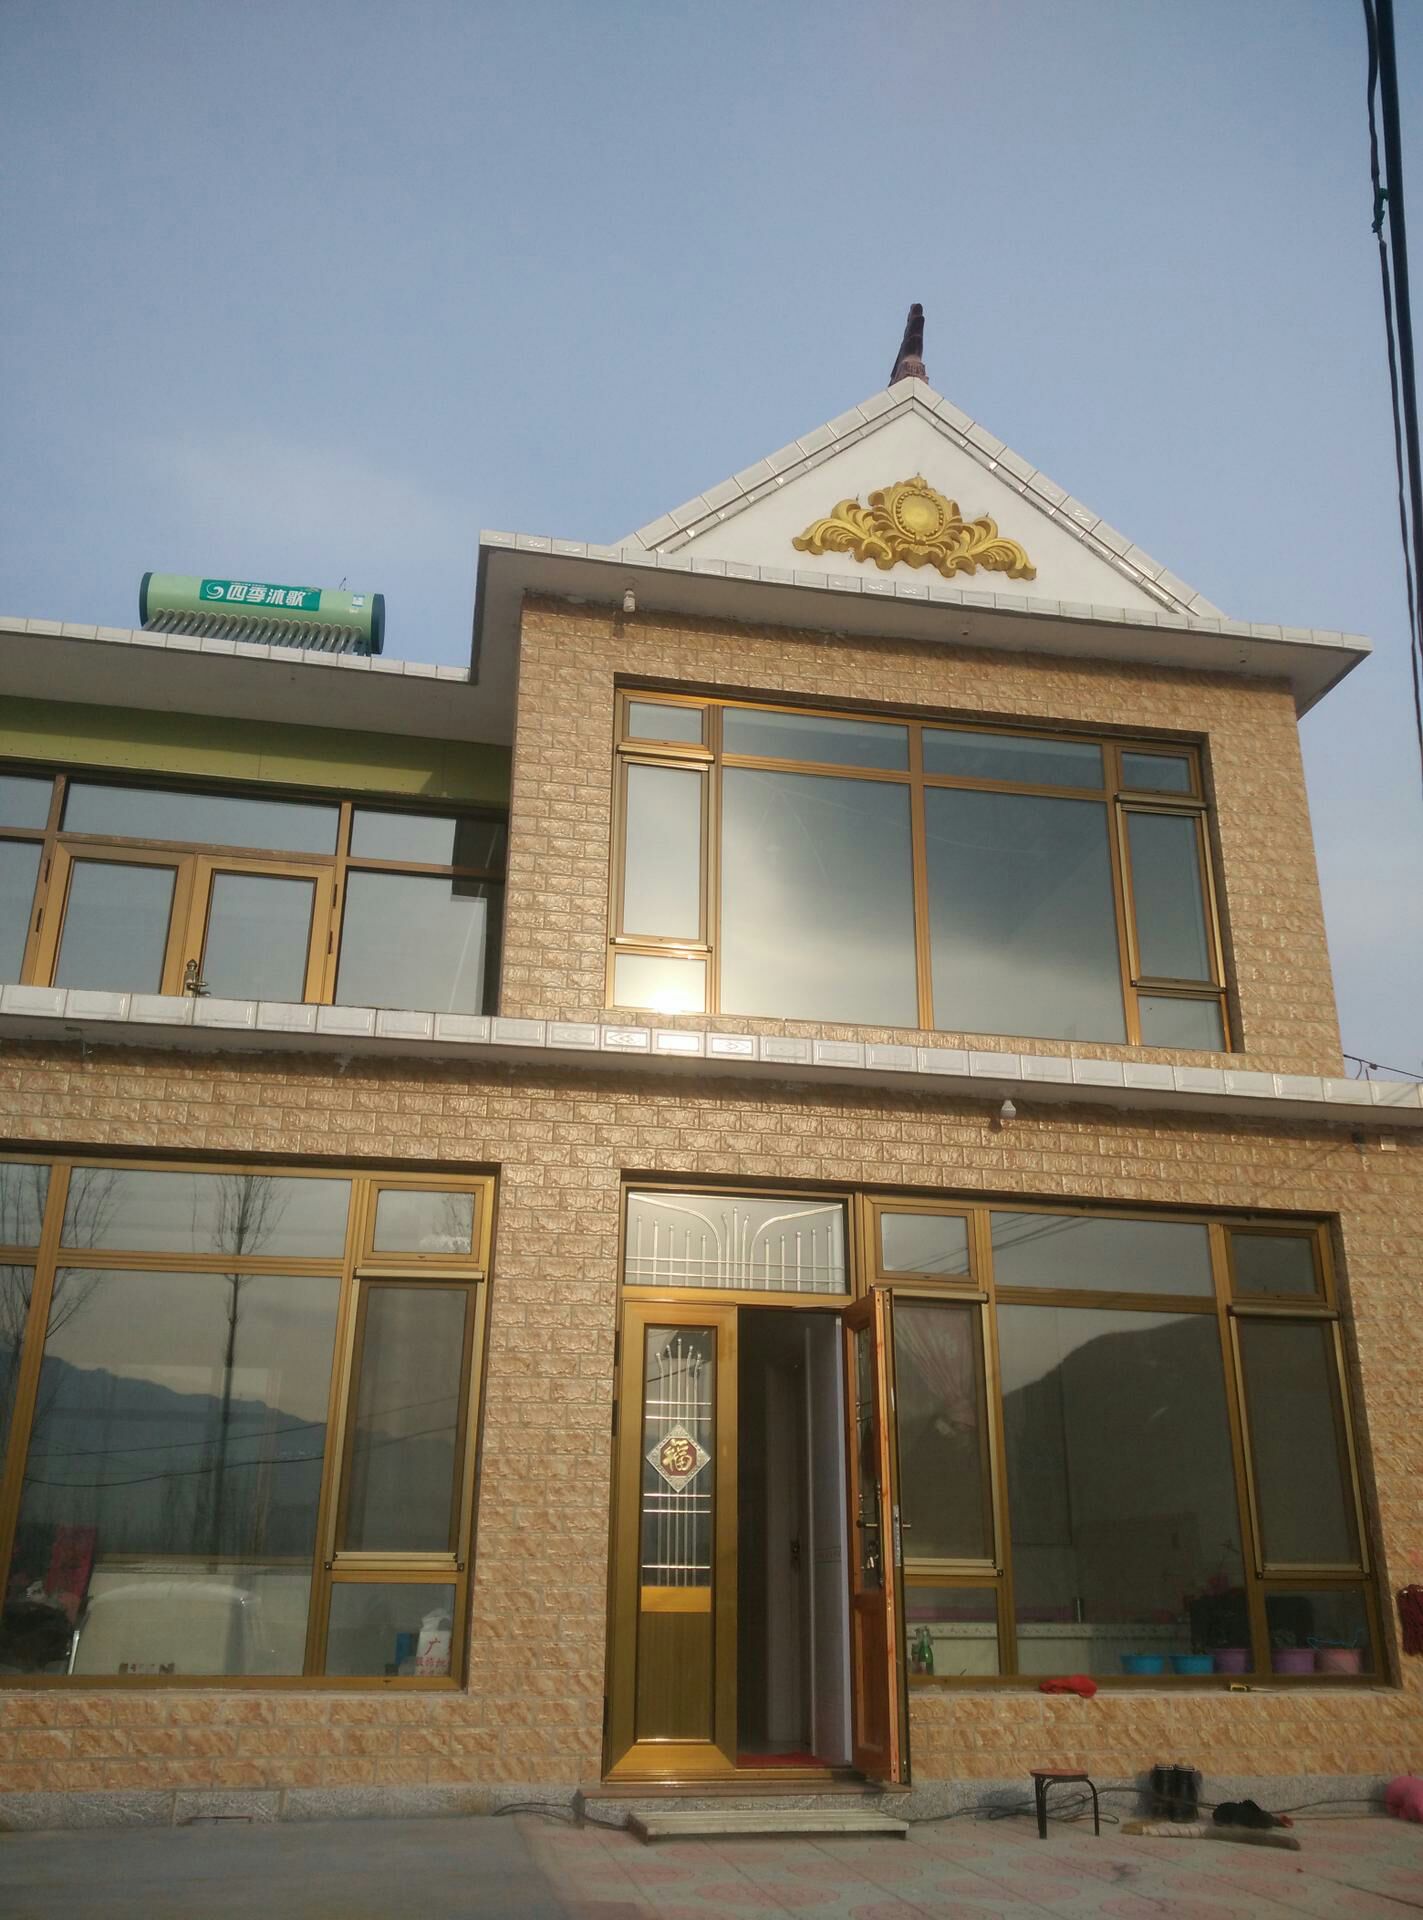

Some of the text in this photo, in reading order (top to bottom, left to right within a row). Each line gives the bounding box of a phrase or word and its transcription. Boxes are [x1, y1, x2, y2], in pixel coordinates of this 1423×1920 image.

[226, 584, 306, 607] 四季沐歌
[662, 1438, 693, 1472] 福
